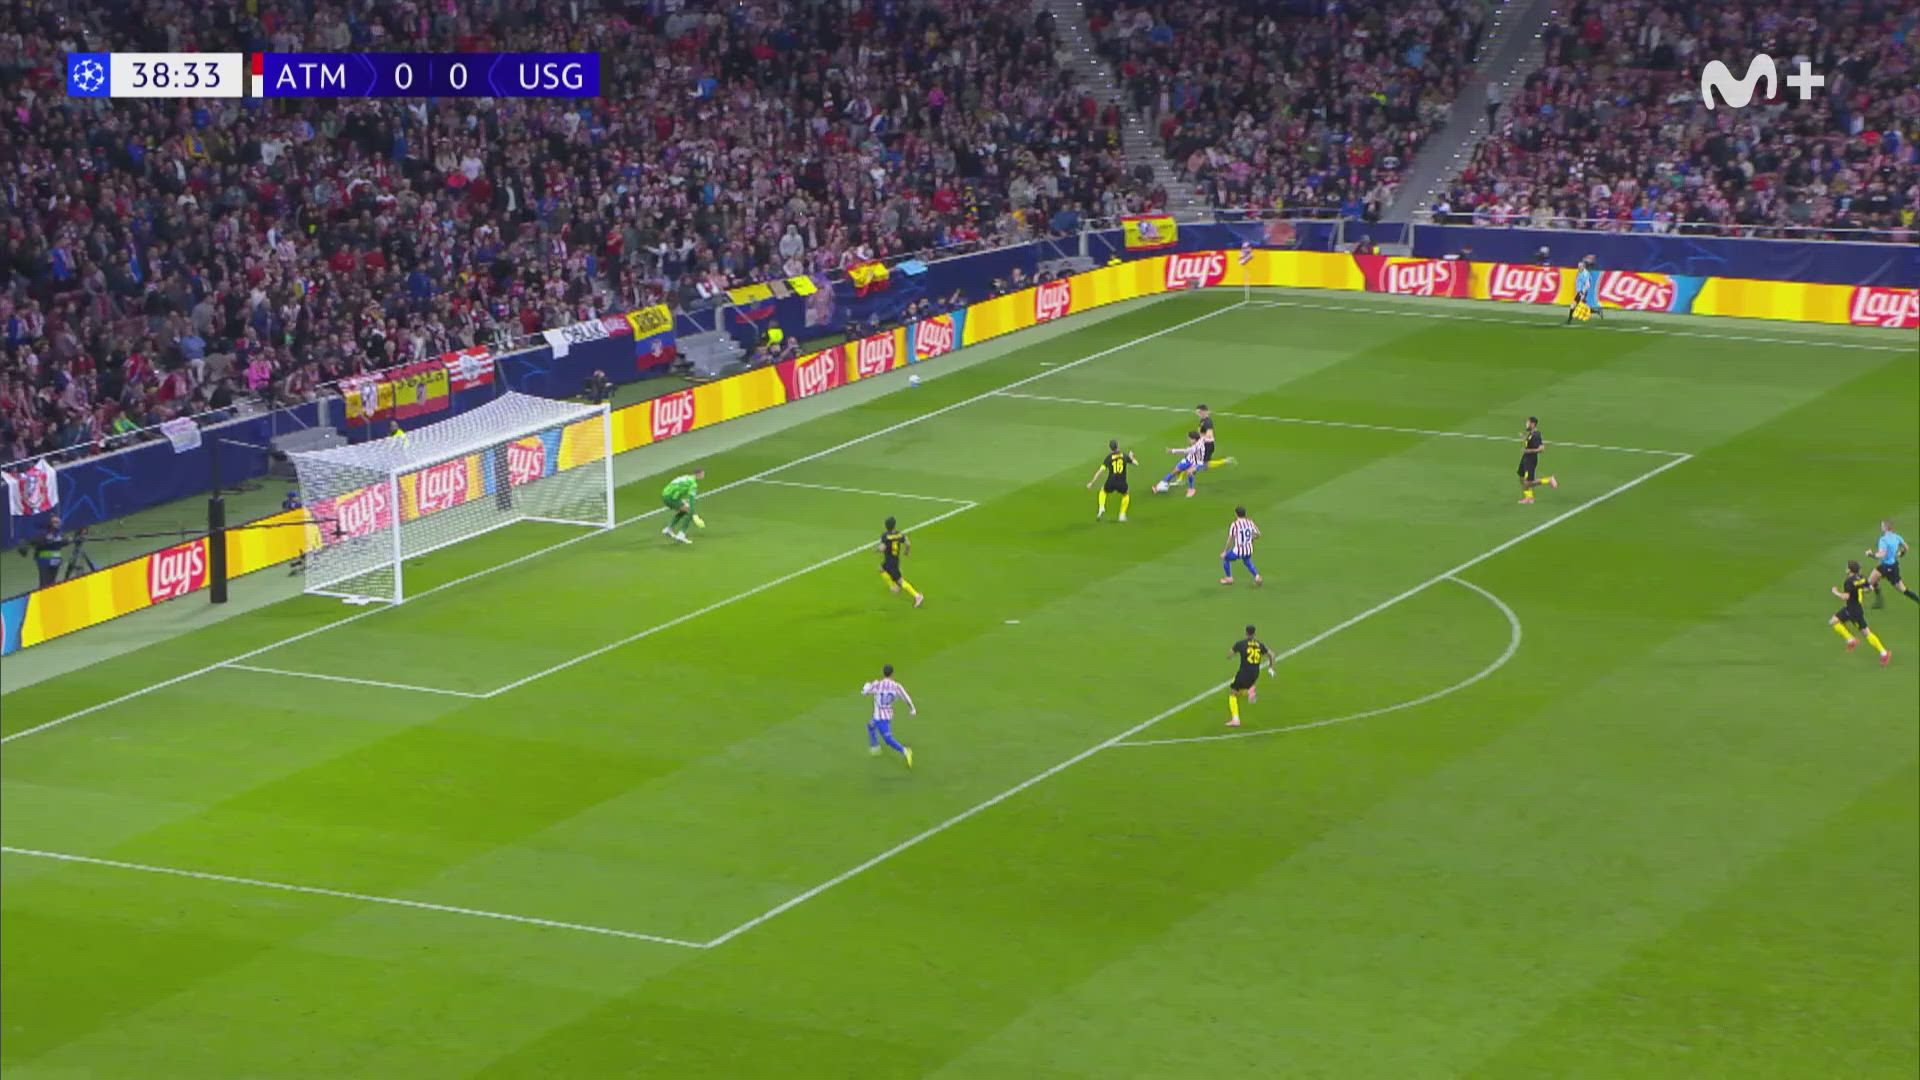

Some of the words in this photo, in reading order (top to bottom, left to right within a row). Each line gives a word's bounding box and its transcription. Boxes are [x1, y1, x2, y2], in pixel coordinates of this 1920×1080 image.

[1166, 251, 1226, 289] Lay's
[1388, 258, 1451, 296] Lay's
[1493, 263, 1557, 304] Lay's
[1599, 270, 1673, 311] Lay's
[1036, 278, 1069, 320] Lay's
[1851, 286, 1920, 328] Lay's
[859, 330, 894, 374] Lay's
[916, 314, 953, 358] Lay's
[798, 348, 835, 398] Lay's
[653, 390, 693, 437] Lay's
[419, 459, 466, 511] Lay's
[1239, 528, 1251, 543] 19
[151, 541, 204, 598] Lay's
